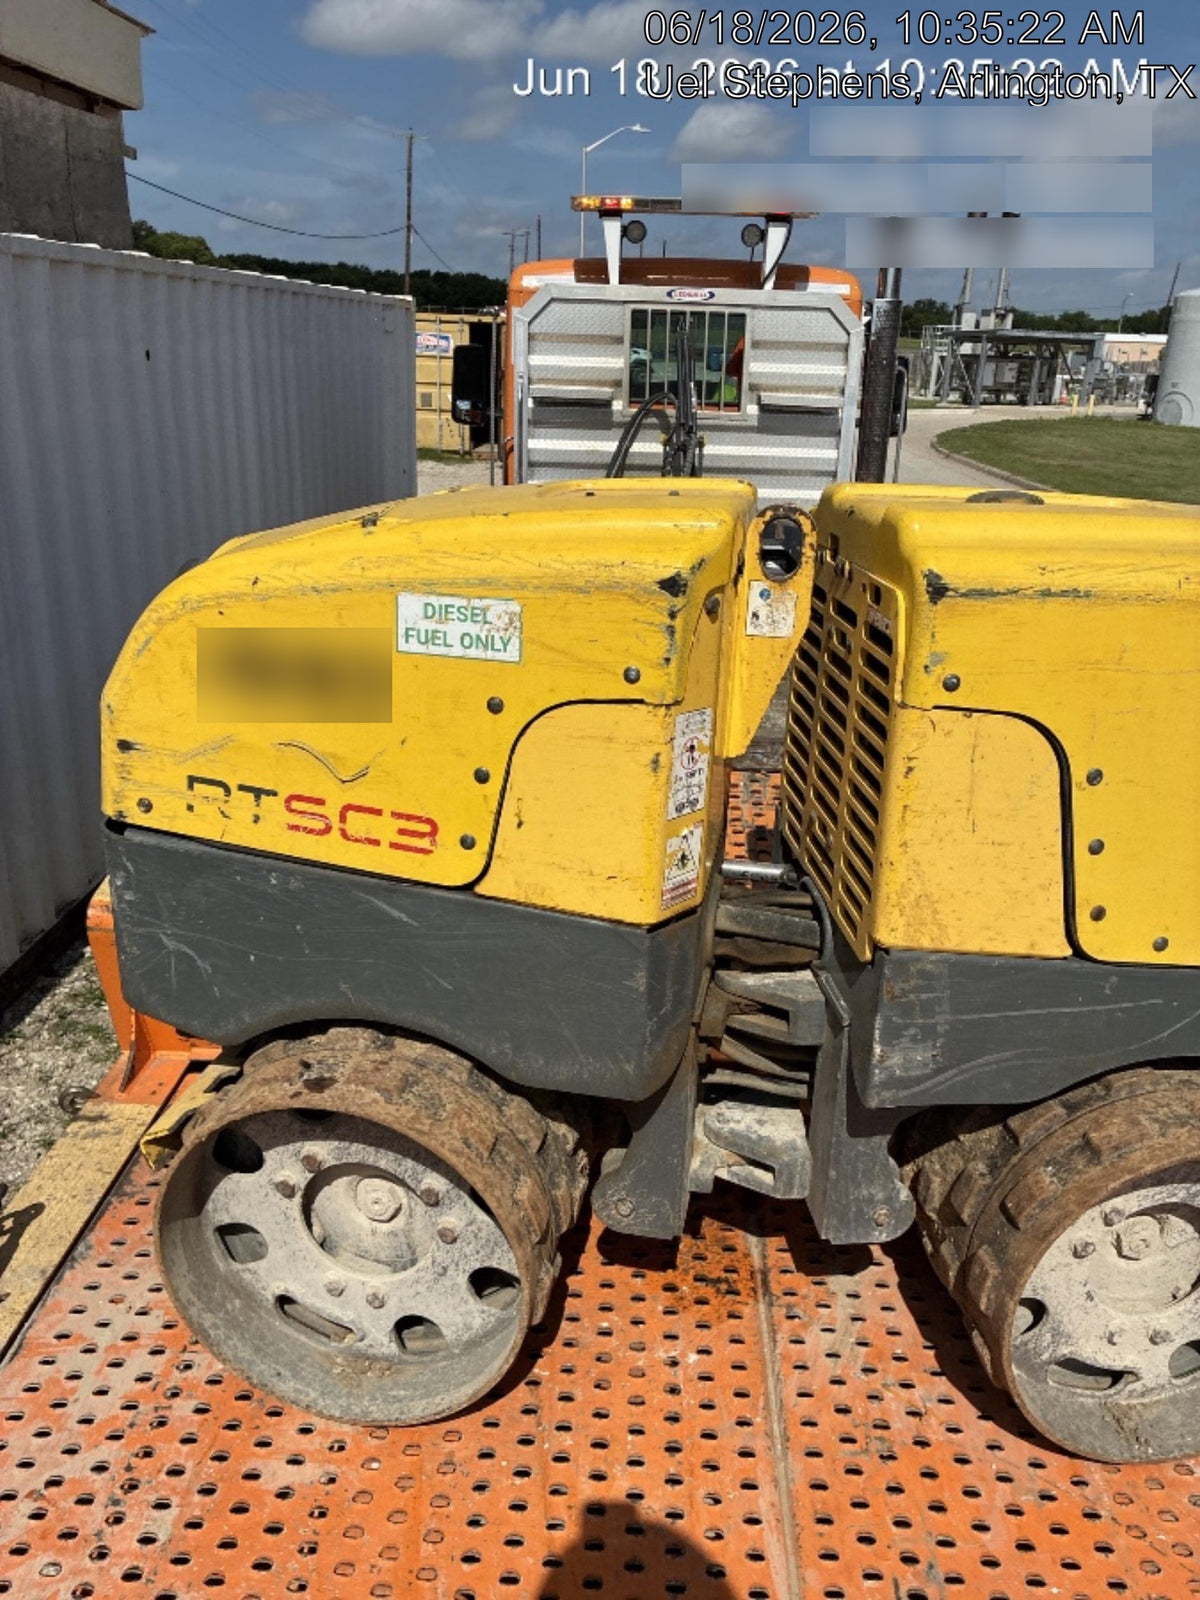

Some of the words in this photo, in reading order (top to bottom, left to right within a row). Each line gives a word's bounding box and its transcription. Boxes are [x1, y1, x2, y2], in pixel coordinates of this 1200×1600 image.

[423, 602, 493, 625] DIESEL
[404, 627, 454, 648] FUEL
[460, 632, 512, 653] ONLY
